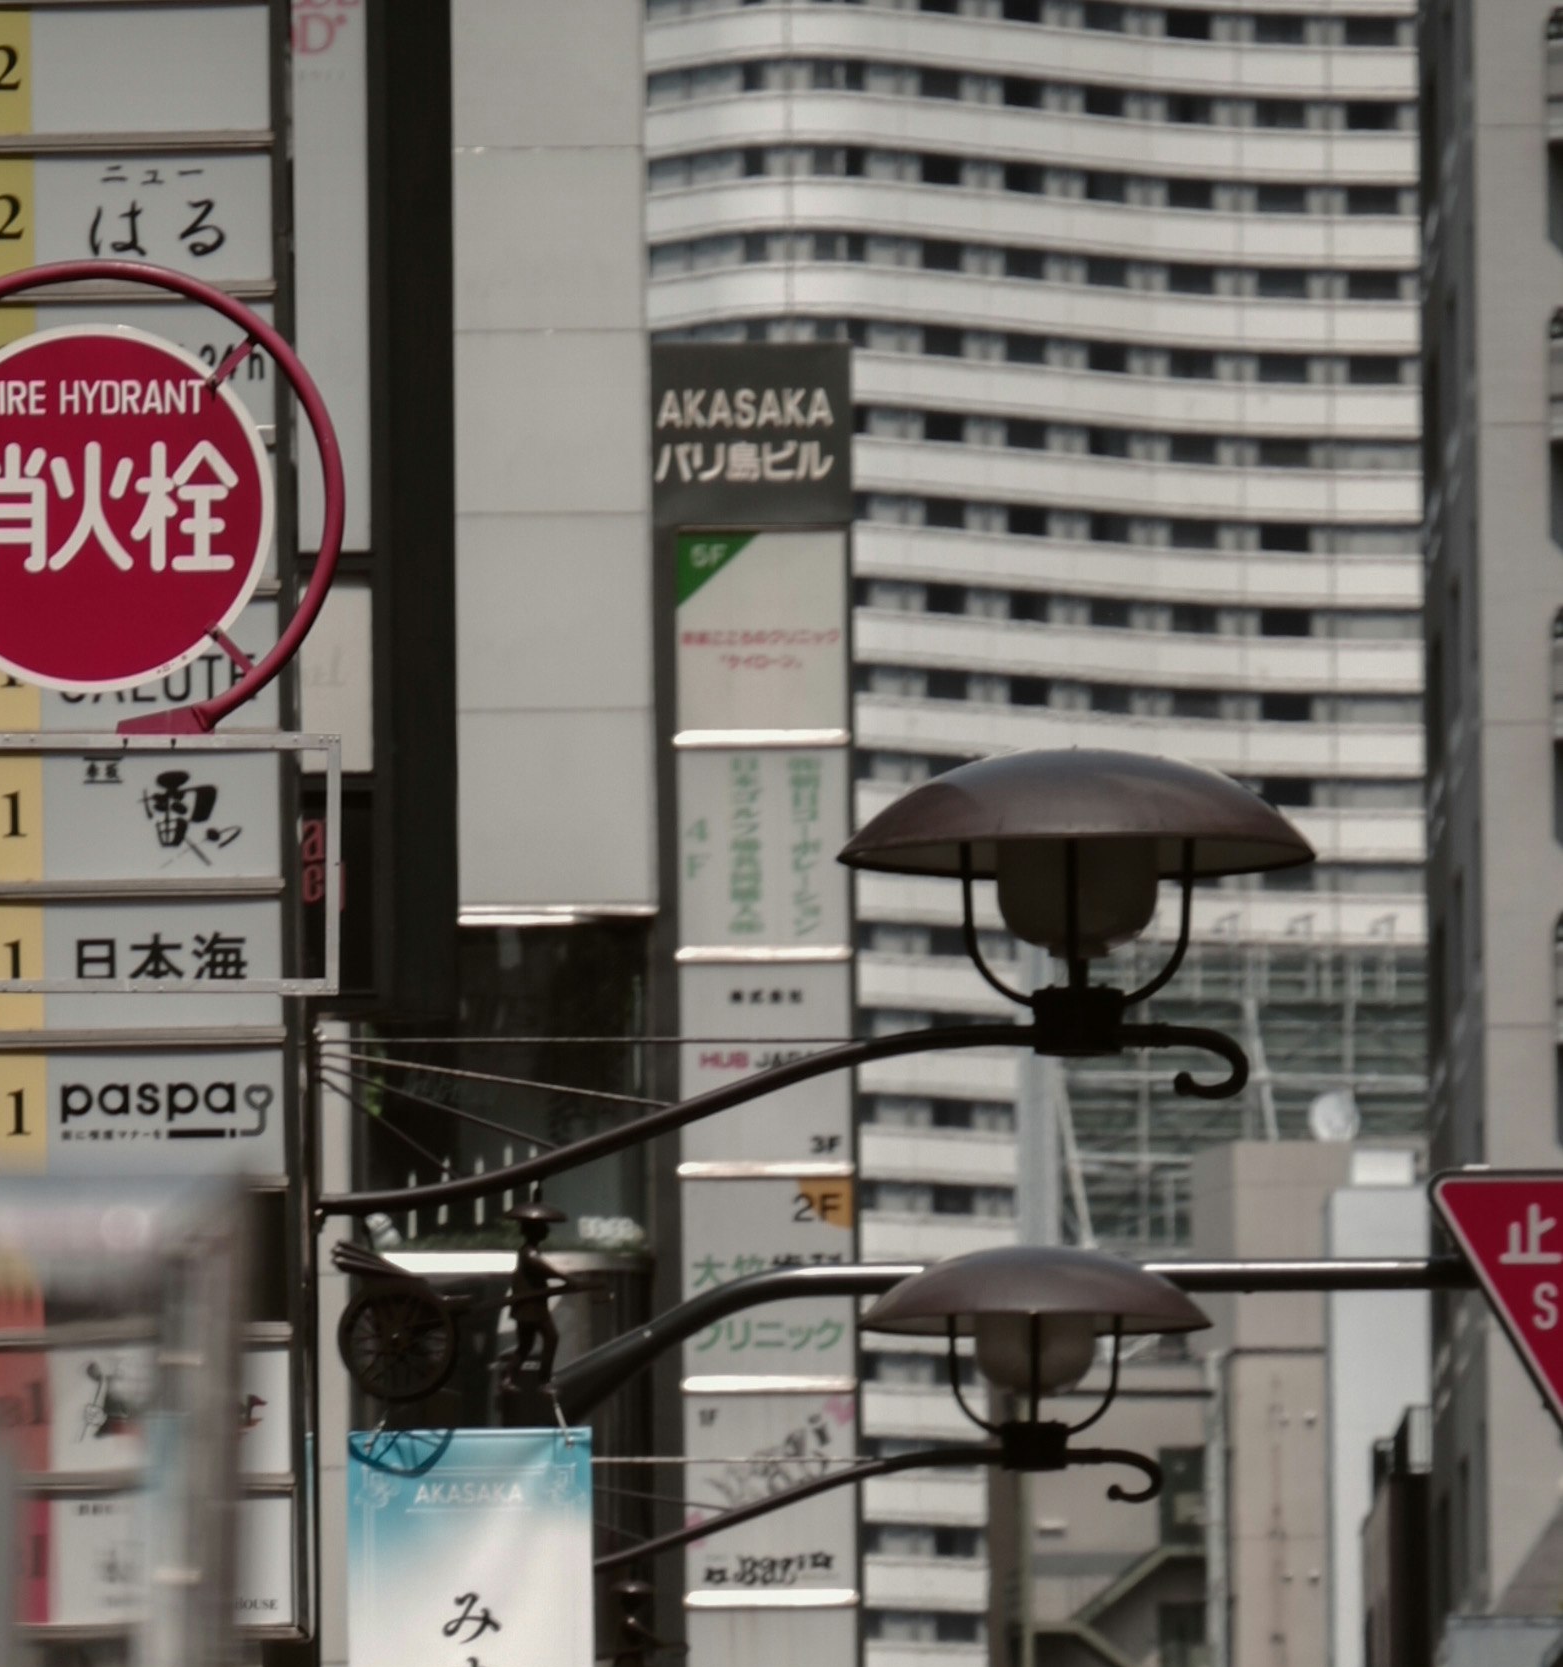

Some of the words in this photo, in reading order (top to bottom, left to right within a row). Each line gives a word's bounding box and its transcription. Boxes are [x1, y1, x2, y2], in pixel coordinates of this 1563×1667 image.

[101, 165, 204, 185] ニュー
[90, 199, 226, 257] はる
[59, 379, 206, 415] HYDRANT
[657, 388, 834, 430] AKASAKA
[654, 441, 834, 483] バリ島ビル
[689, 544, 728, 568] 5F
[0, 791, 27, 837] 1
[3, 938, 21, 979] 1
[75, 932, 248, 979] 日本海
[699, 1052, 750, 1069] HUB
[7, 1088, 31, 1137] 1
[60, 1082, 236, 1124] paspa
[811, 1135, 841, 1153] 3F
[792, 1193, 842, 1222] 2F
[696, 1319, 845, 1352] クリニック
[414, 1481, 524, 1504] AKASAKA
